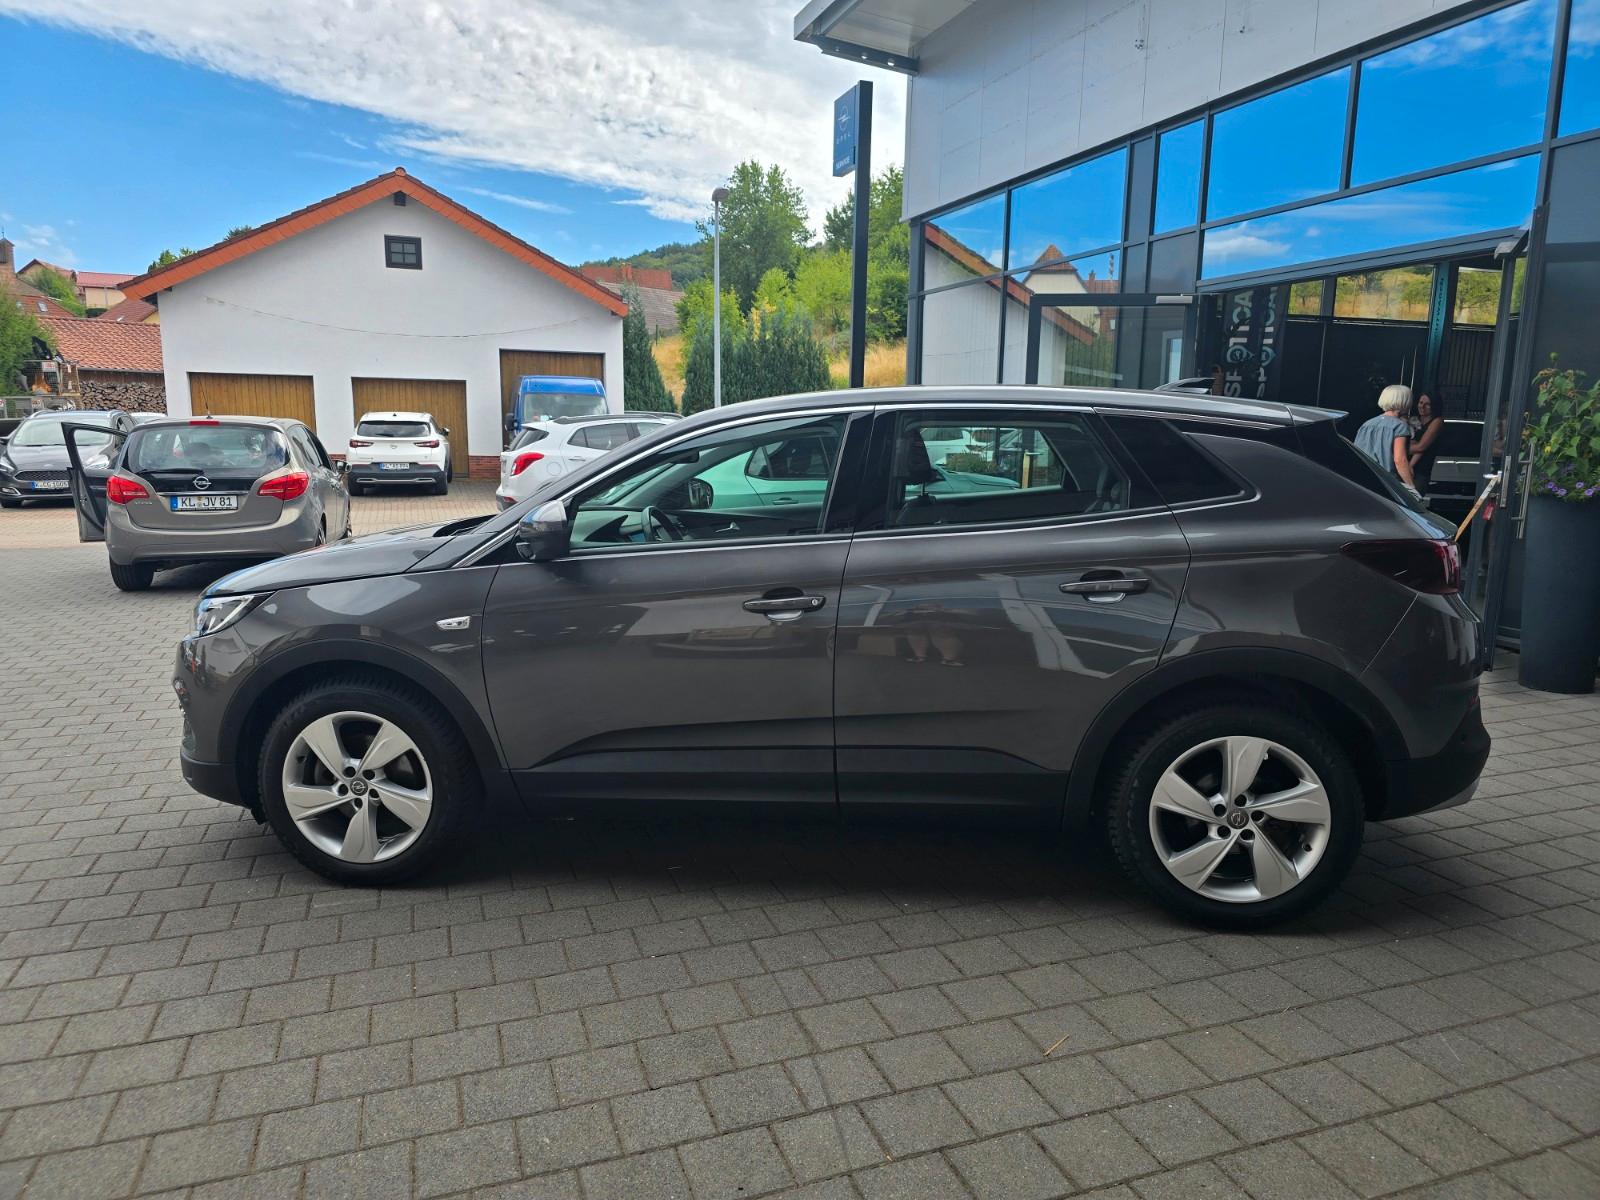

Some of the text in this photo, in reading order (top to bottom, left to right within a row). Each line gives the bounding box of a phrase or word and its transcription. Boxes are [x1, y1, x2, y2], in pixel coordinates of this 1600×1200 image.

[181, 496, 233, 508] KL JV 81
